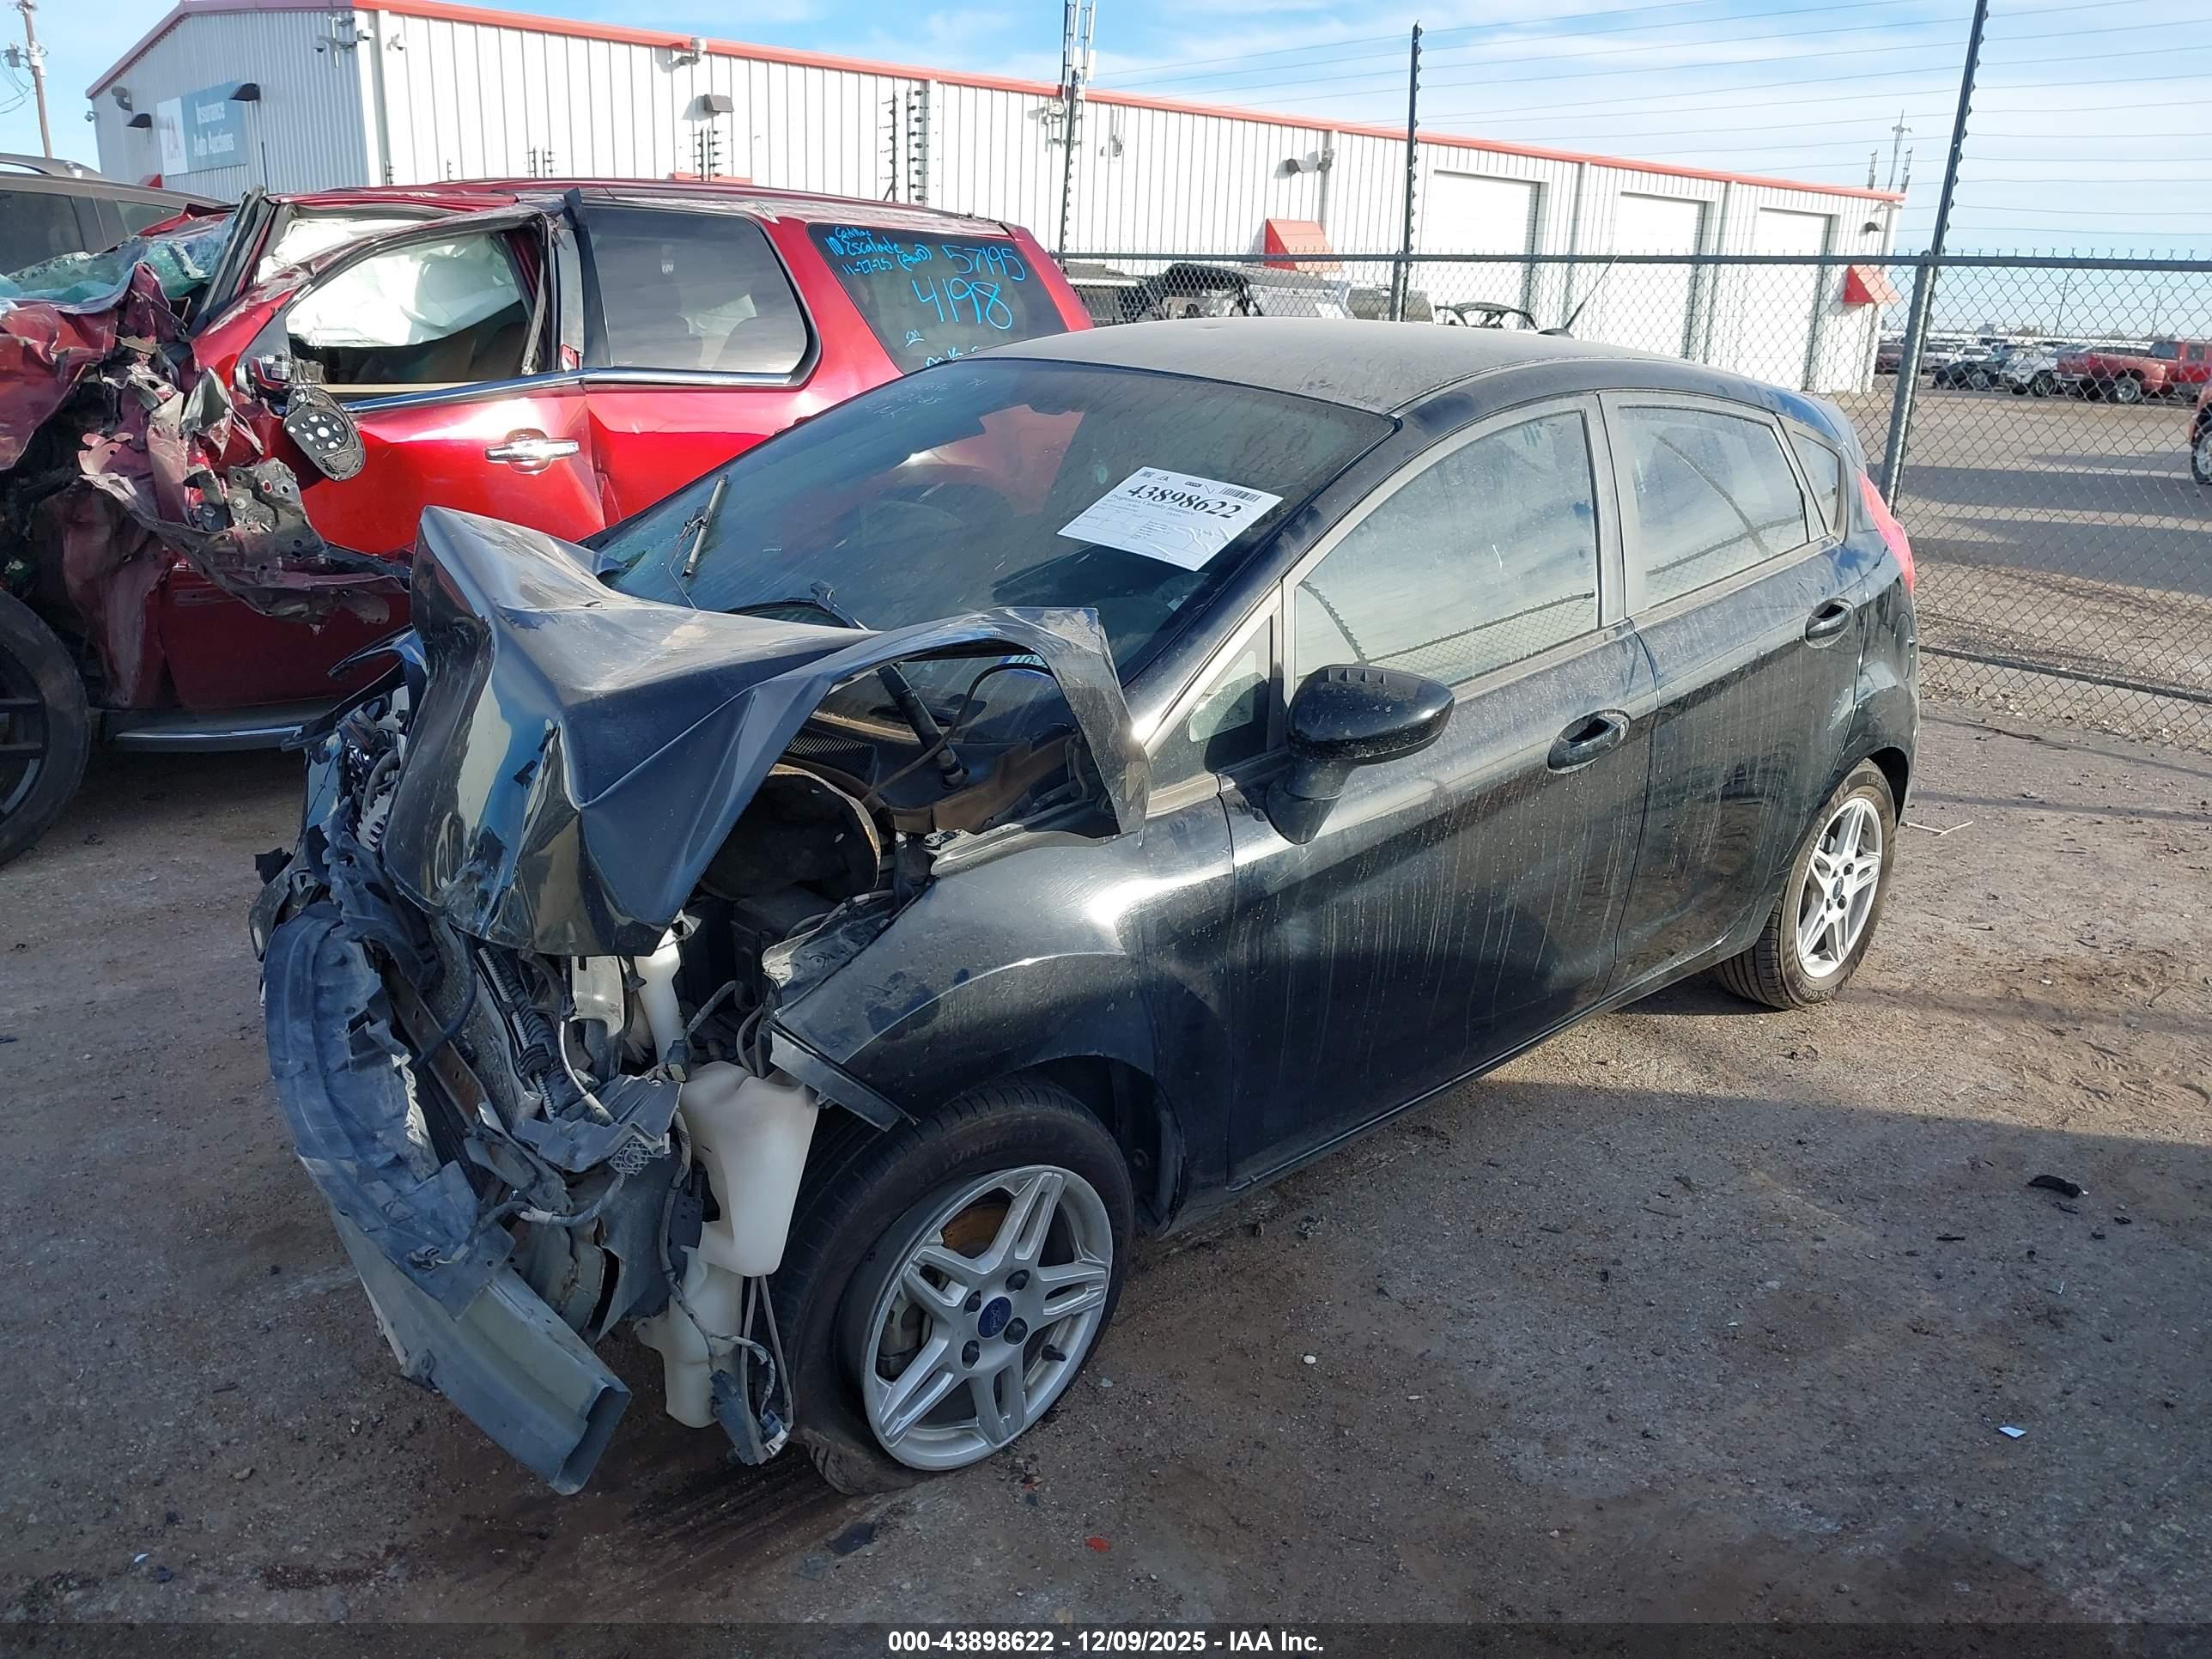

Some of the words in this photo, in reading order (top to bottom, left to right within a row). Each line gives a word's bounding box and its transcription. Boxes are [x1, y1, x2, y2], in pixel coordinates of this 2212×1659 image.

[941, 245, 1025, 282] 57195
[911, 276, 1012, 330] 4198
[1127, 484, 1242, 520] 43898622
